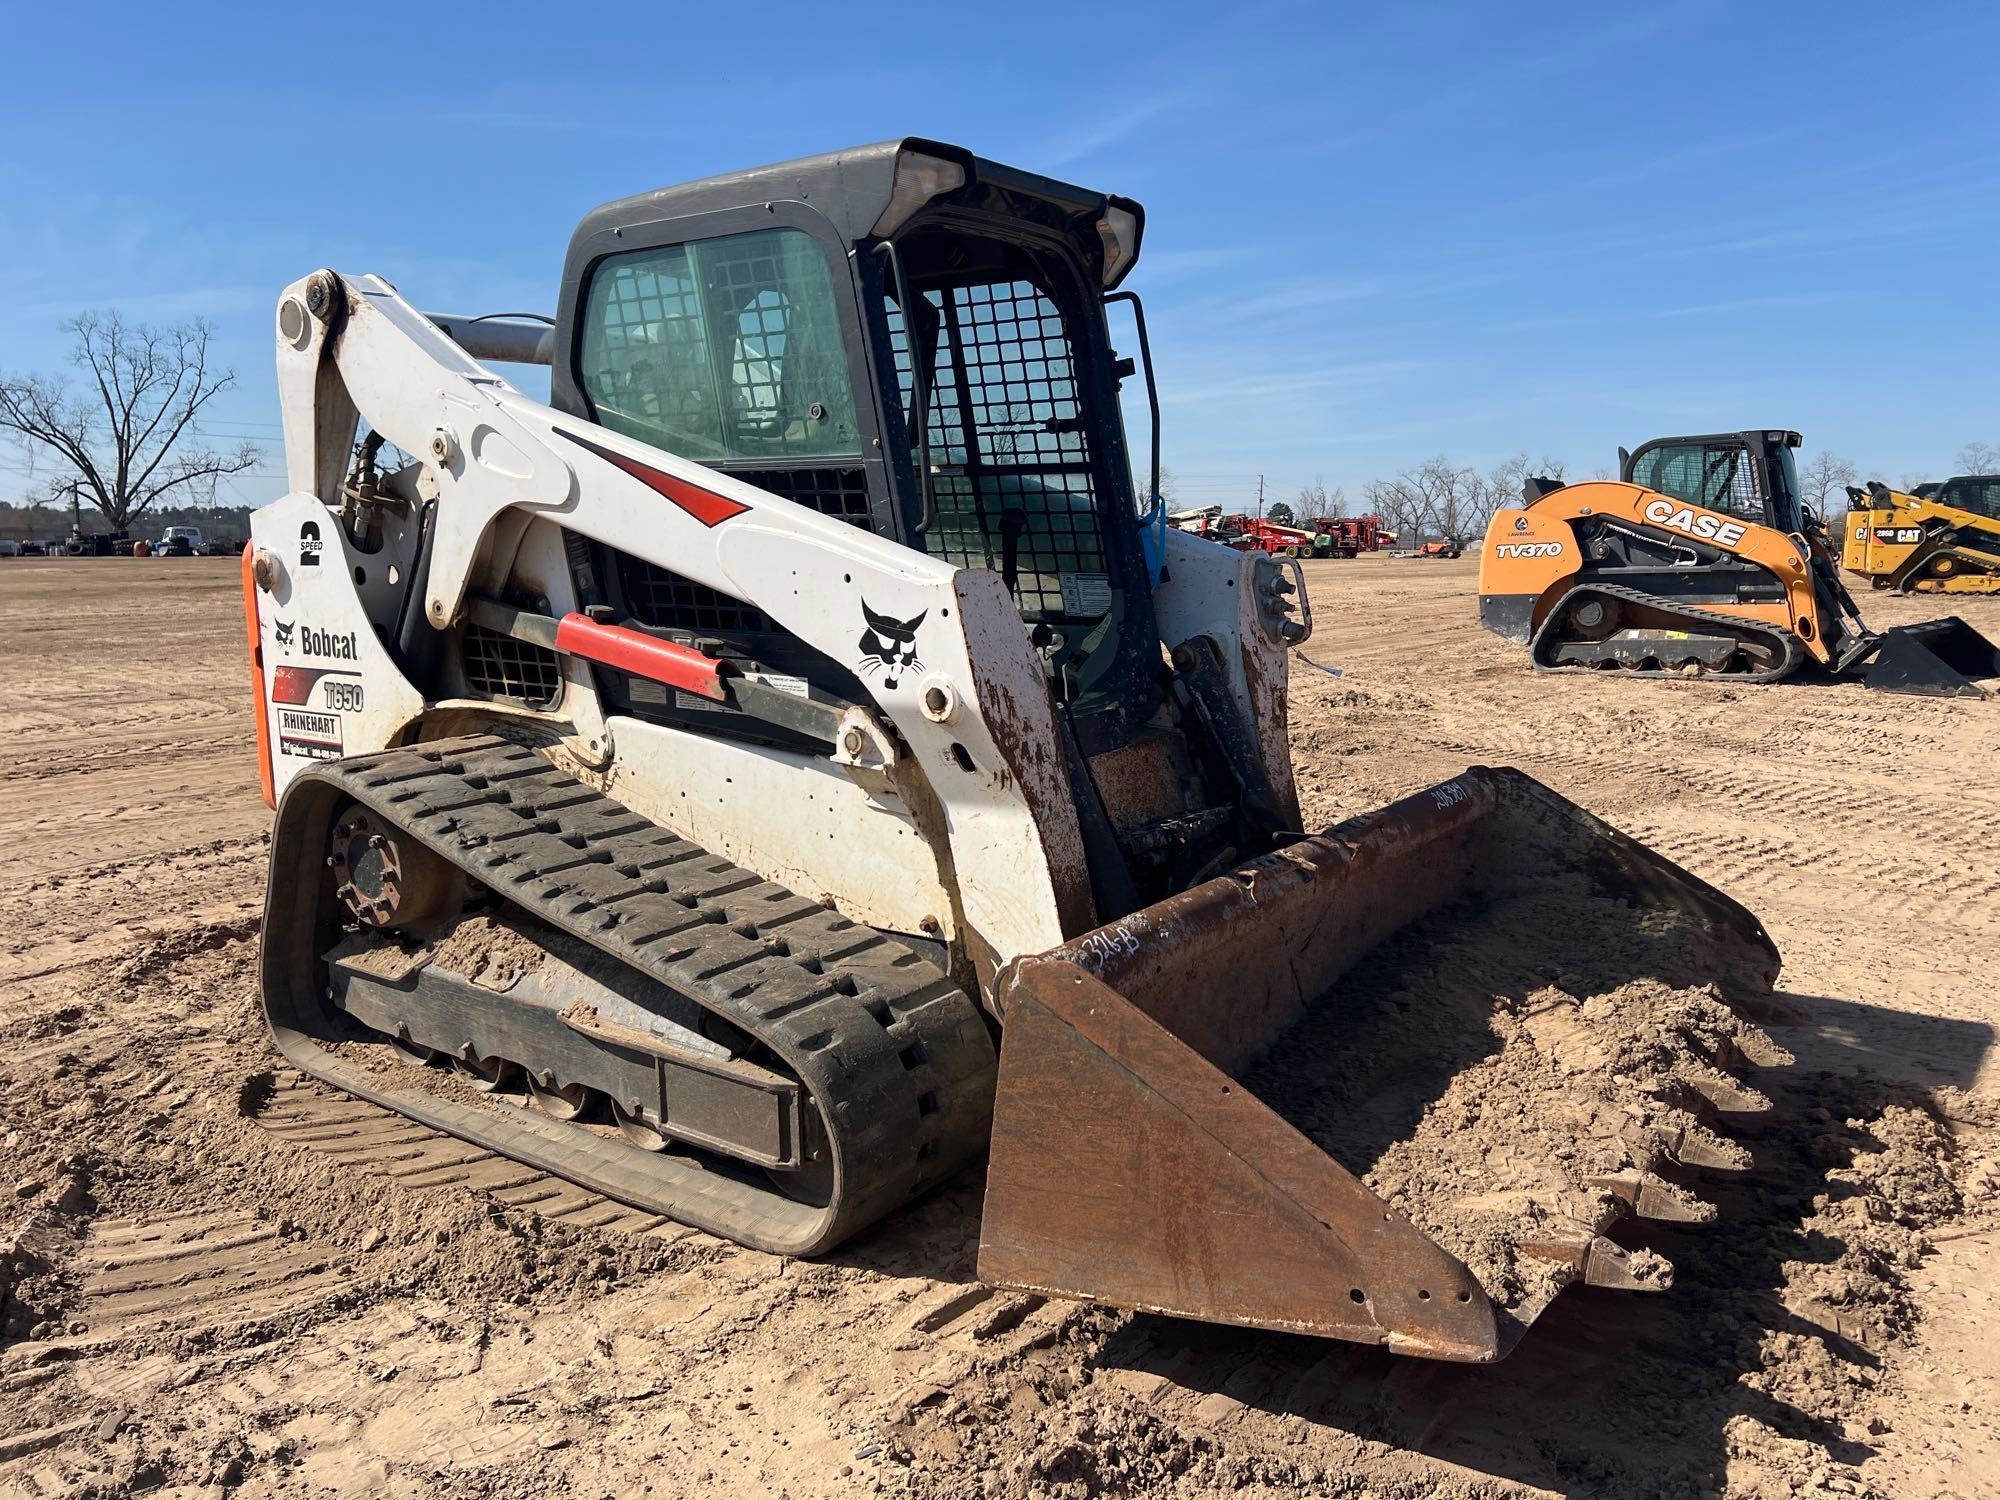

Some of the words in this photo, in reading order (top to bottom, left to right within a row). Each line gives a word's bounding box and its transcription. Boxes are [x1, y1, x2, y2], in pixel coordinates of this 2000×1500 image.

[1645, 500, 1748, 547] CASE
[1856, 527, 1868, 540] CA
[1897, 529, 1920, 542] CAT
[300, 520, 320, 566] 2
[300, 541, 323, 550] SPEED
[1496, 542, 1563, 558] TV370
[301, 626, 358, 660] Bobcat
[324, 681, 364, 713] T650
[283, 712, 335, 734] RHINEHART
[1081, 927, 1140, 969] 326-B
